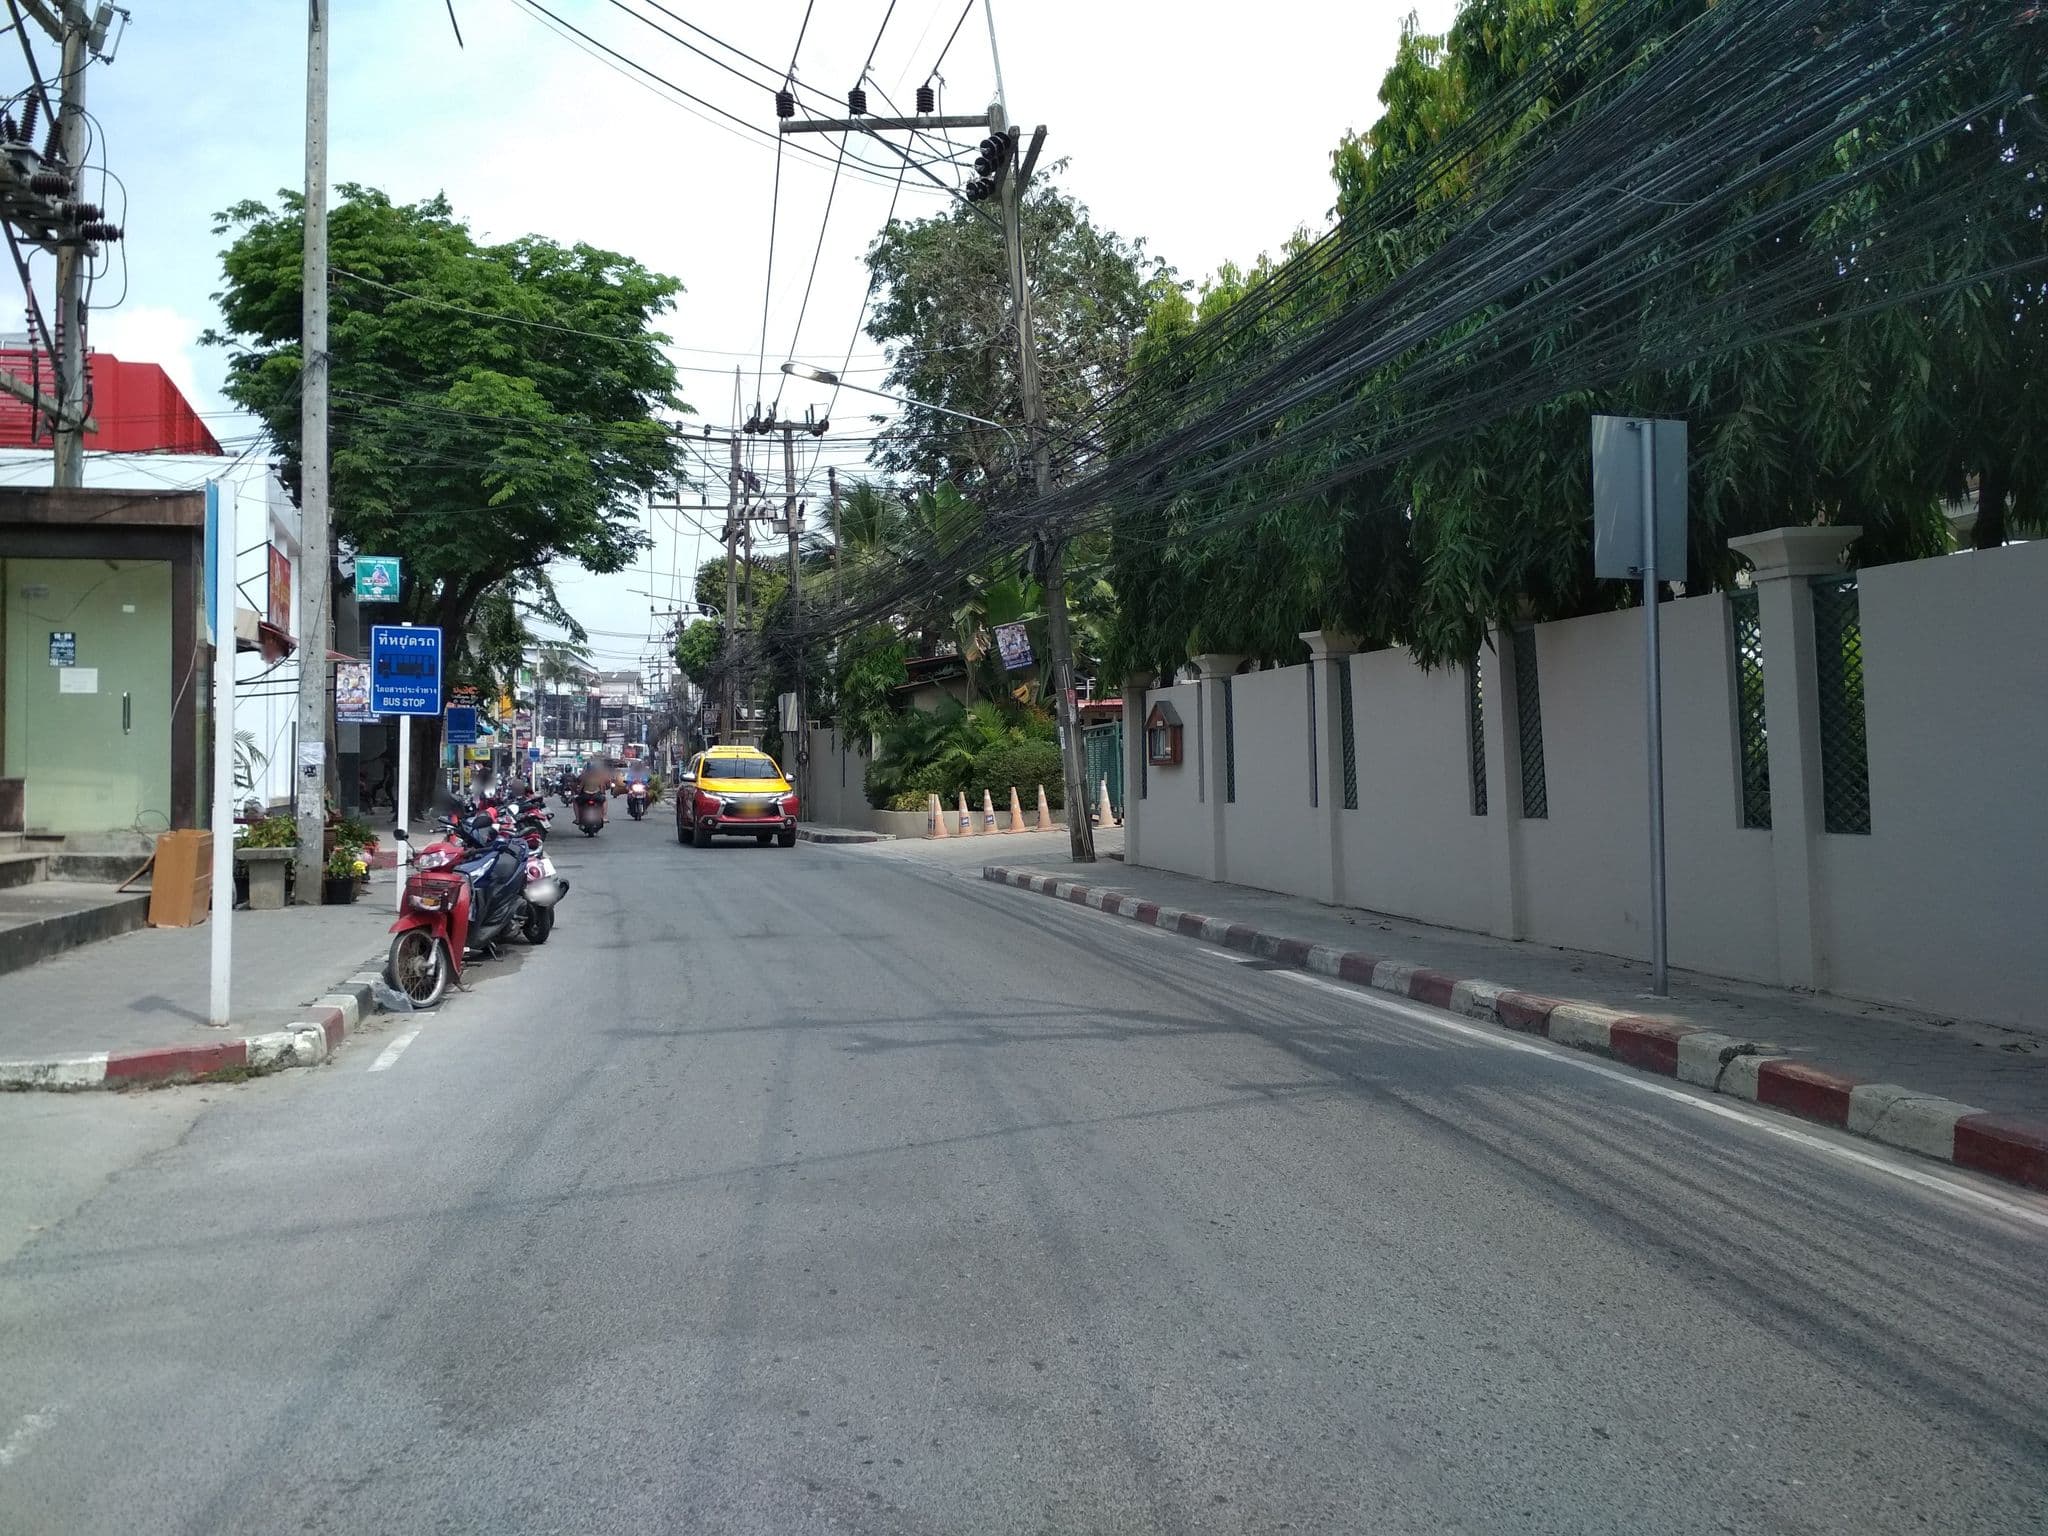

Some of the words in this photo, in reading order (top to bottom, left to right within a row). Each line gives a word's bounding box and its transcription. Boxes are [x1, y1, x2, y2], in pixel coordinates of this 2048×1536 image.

[378, 629, 435, 650] ที่หยุดรถ
[383, 697, 401, 706] BUS
[402, 698, 426, 708] STOP
